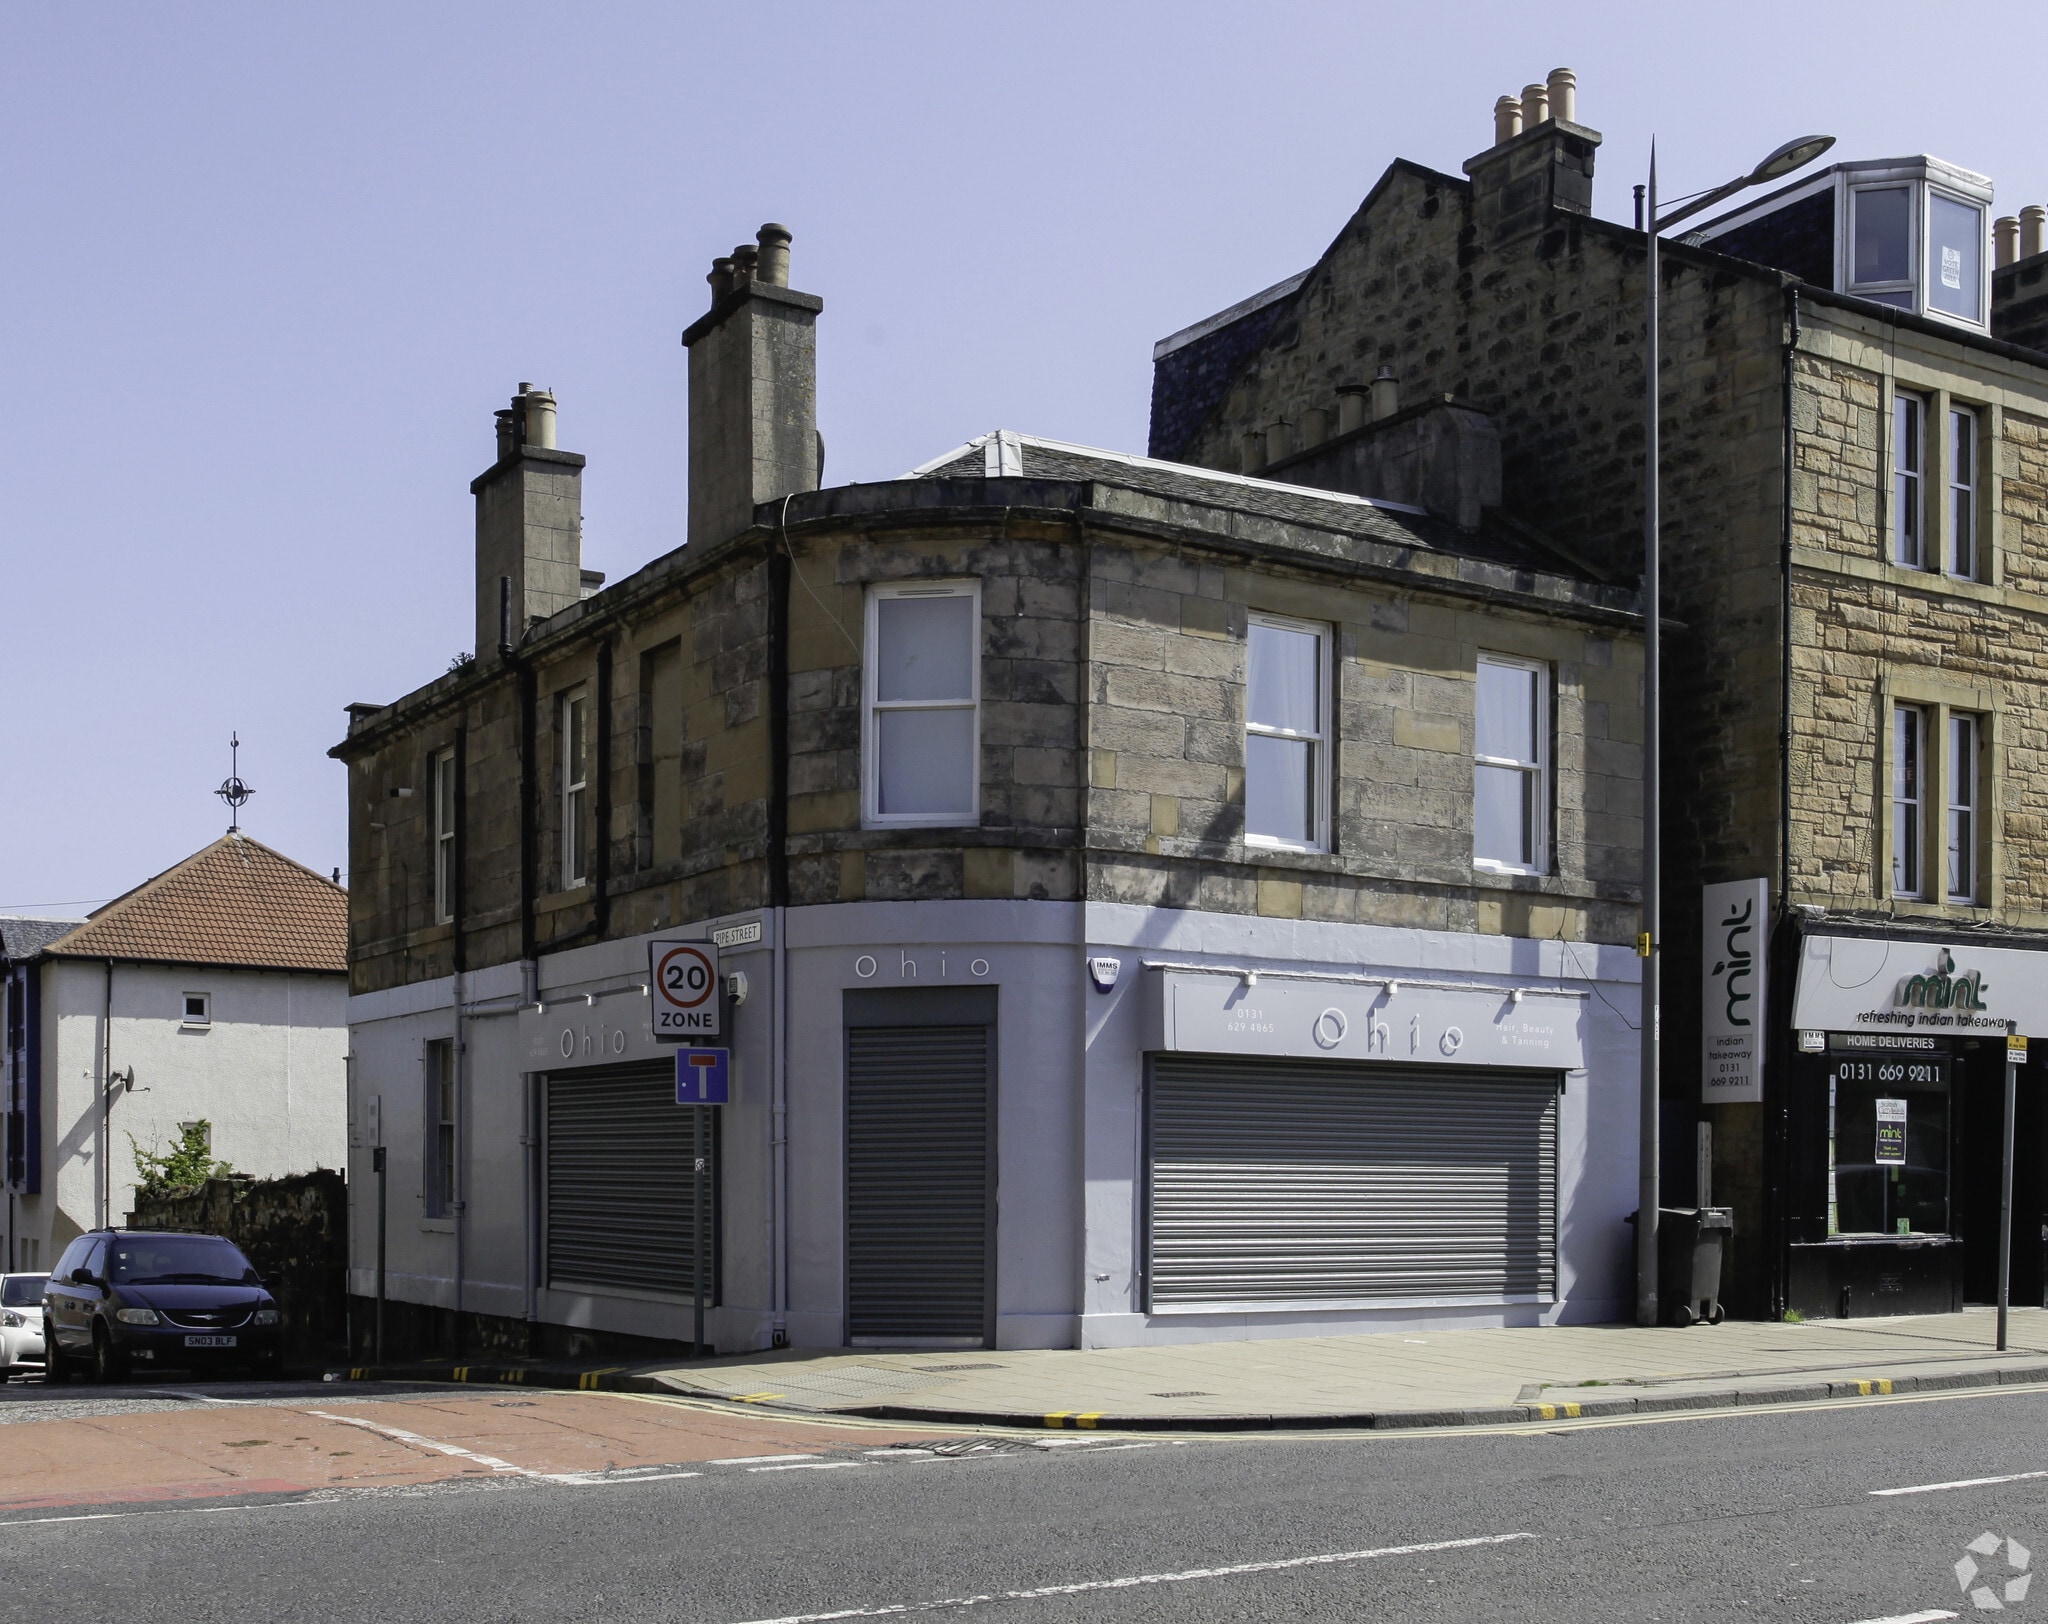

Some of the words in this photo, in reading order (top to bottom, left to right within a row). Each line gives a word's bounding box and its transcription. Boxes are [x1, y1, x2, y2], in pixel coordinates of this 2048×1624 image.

[716, 931, 730, 945] PIPE
[731, 926, 757, 942] STREET
[856, 950, 989, 978] Ohio
[1712, 898, 1752, 1026] mint
[666, 965, 706, 990] 20
[1894, 947, 1989, 1011] mint
[661, 1012, 713, 1028] ZONE
[1237, 1008, 1263, 1019] 0131
[1857, 1010, 1915, 1027] refreshing
[1918, 1012, 1954, 1026] indian
[1227, 1022, 1246, 1032] 629
[1250, 1023, 1274, 1033] 4865
[1319, 1007, 1464, 1049] Ohio
[1496, 1022, 1519, 1034] Hair,
[1523, 1023, 1554, 1036] Beauty
[560, 1024, 625, 1058] Ohio
[1501, 1035, 1508, 1044] &
[1512, 1035, 1550, 1049] Tanning
[1716, 1036, 1744, 1046] indian
[1847, 1035, 1877, 1047] HOME
[1878, 1036, 1935, 1049] DELIVERIES
[1709, 1051, 1752, 1060] takeaway
[1719, 1063, 1740, 1072] 0131
[1840, 1063, 1872, 1080] 0131
[1879, 1064, 1904, 1080] 669
[1908, 1065, 1939, 1082] 9211
[1710, 1077, 1727, 1086] 669
[1728, 1075, 1749, 1086] 9211
[1880, 1124, 1902, 1139] mint
[188, 1336, 213, 1346] SN03
